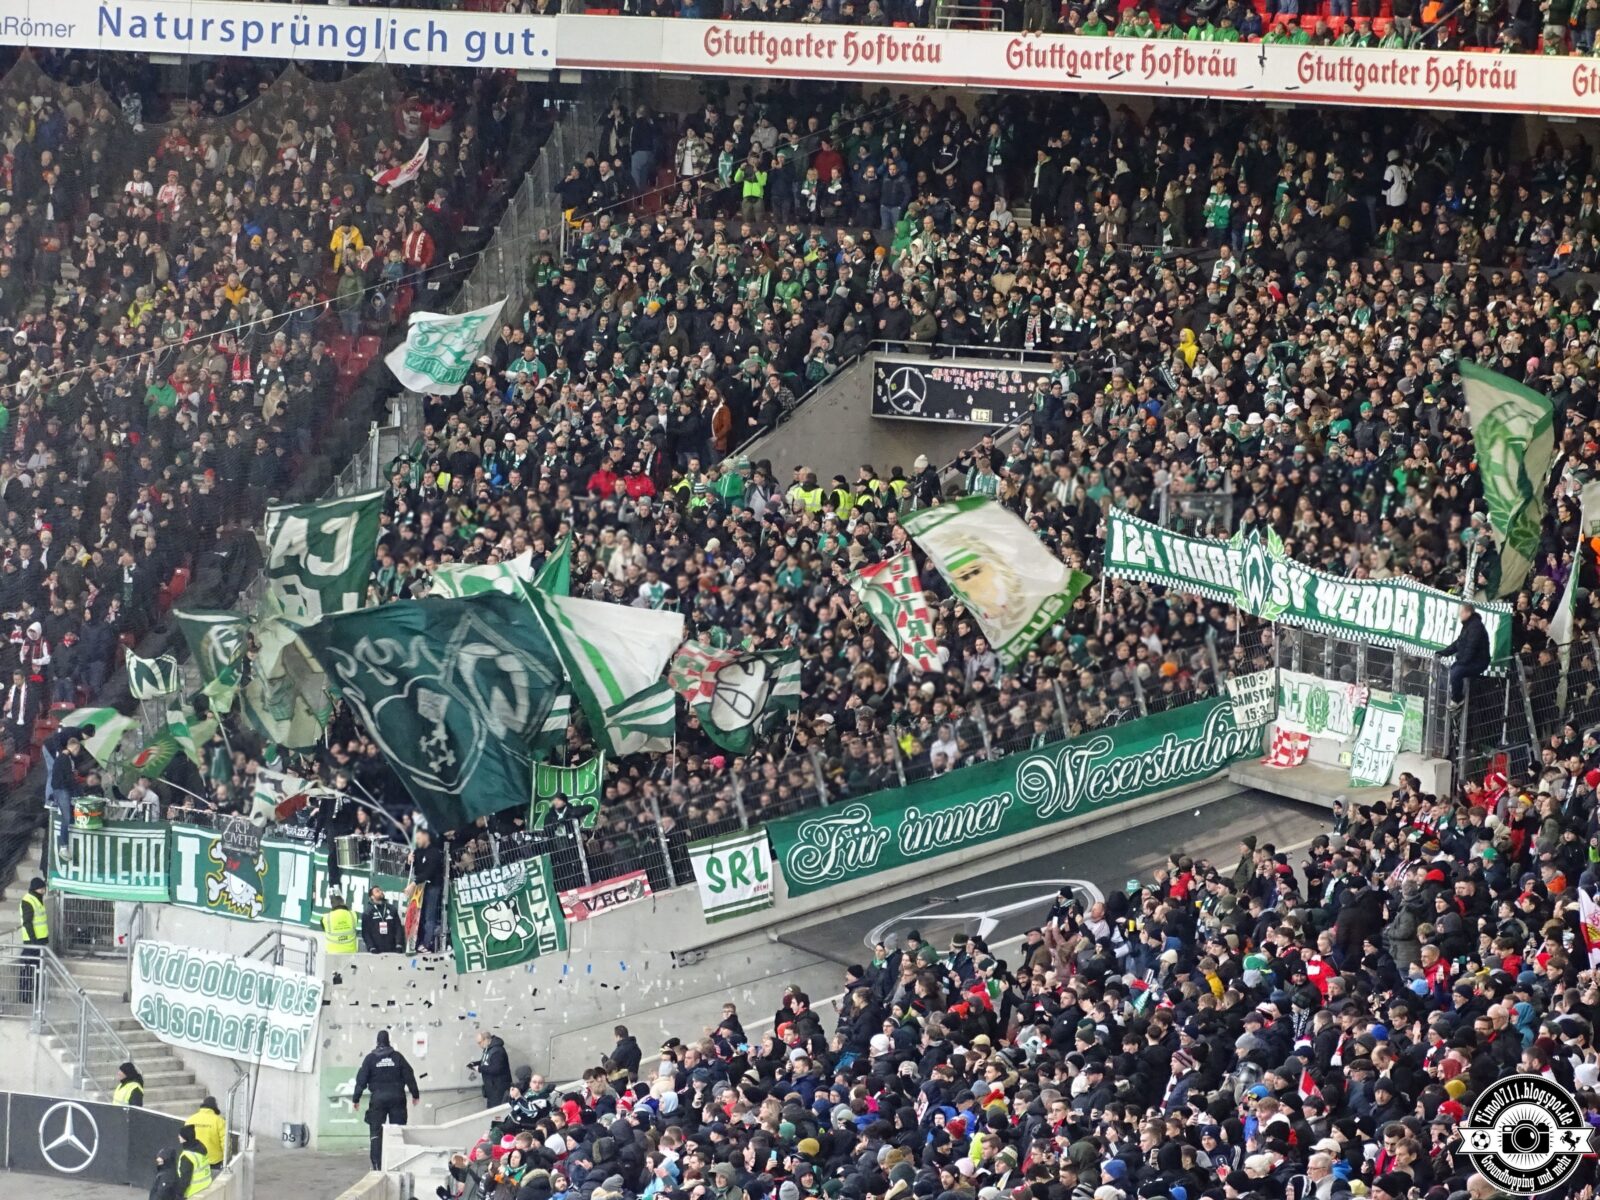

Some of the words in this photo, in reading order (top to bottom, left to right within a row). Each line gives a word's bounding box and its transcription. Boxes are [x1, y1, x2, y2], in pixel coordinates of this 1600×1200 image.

[0, 16, 76, 38] Römer
[98, 5, 450, 53] Natursprünglich
[464, 30, 549, 62] gut.
[703, 25, 837, 64] Stuttgarter
[843, 31, 942, 66] Hofbräu
[1006, 38, 1135, 75] Stuttgarter
[1141, 44, 1237, 79] Hofbräu
[1297, 51, 1420, 91] Stuttgarter
[1425, 56, 1518, 93] Hofbräu
[1573, 63, 1600, 97] St
[1110, 519, 1162, 569] 124
[1162, 535, 1242, 592] JAHRE
[1315, 577, 1419, 637] WERDER
[1420, 596, 1500, 659] BREN
[1235, 675, 1256, 690] PRO
[789, 805, 888, 882] Für
[901, 794, 1011, 856] immer
[1018, 703, 1260, 815] Weserstadion
[706, 847, 768, 894] SRL
[460, 881, 508, 905] HAIFA
[524, 859, 558, 955] BOYS
[139, 943, 320, 1016] Videobeweis
